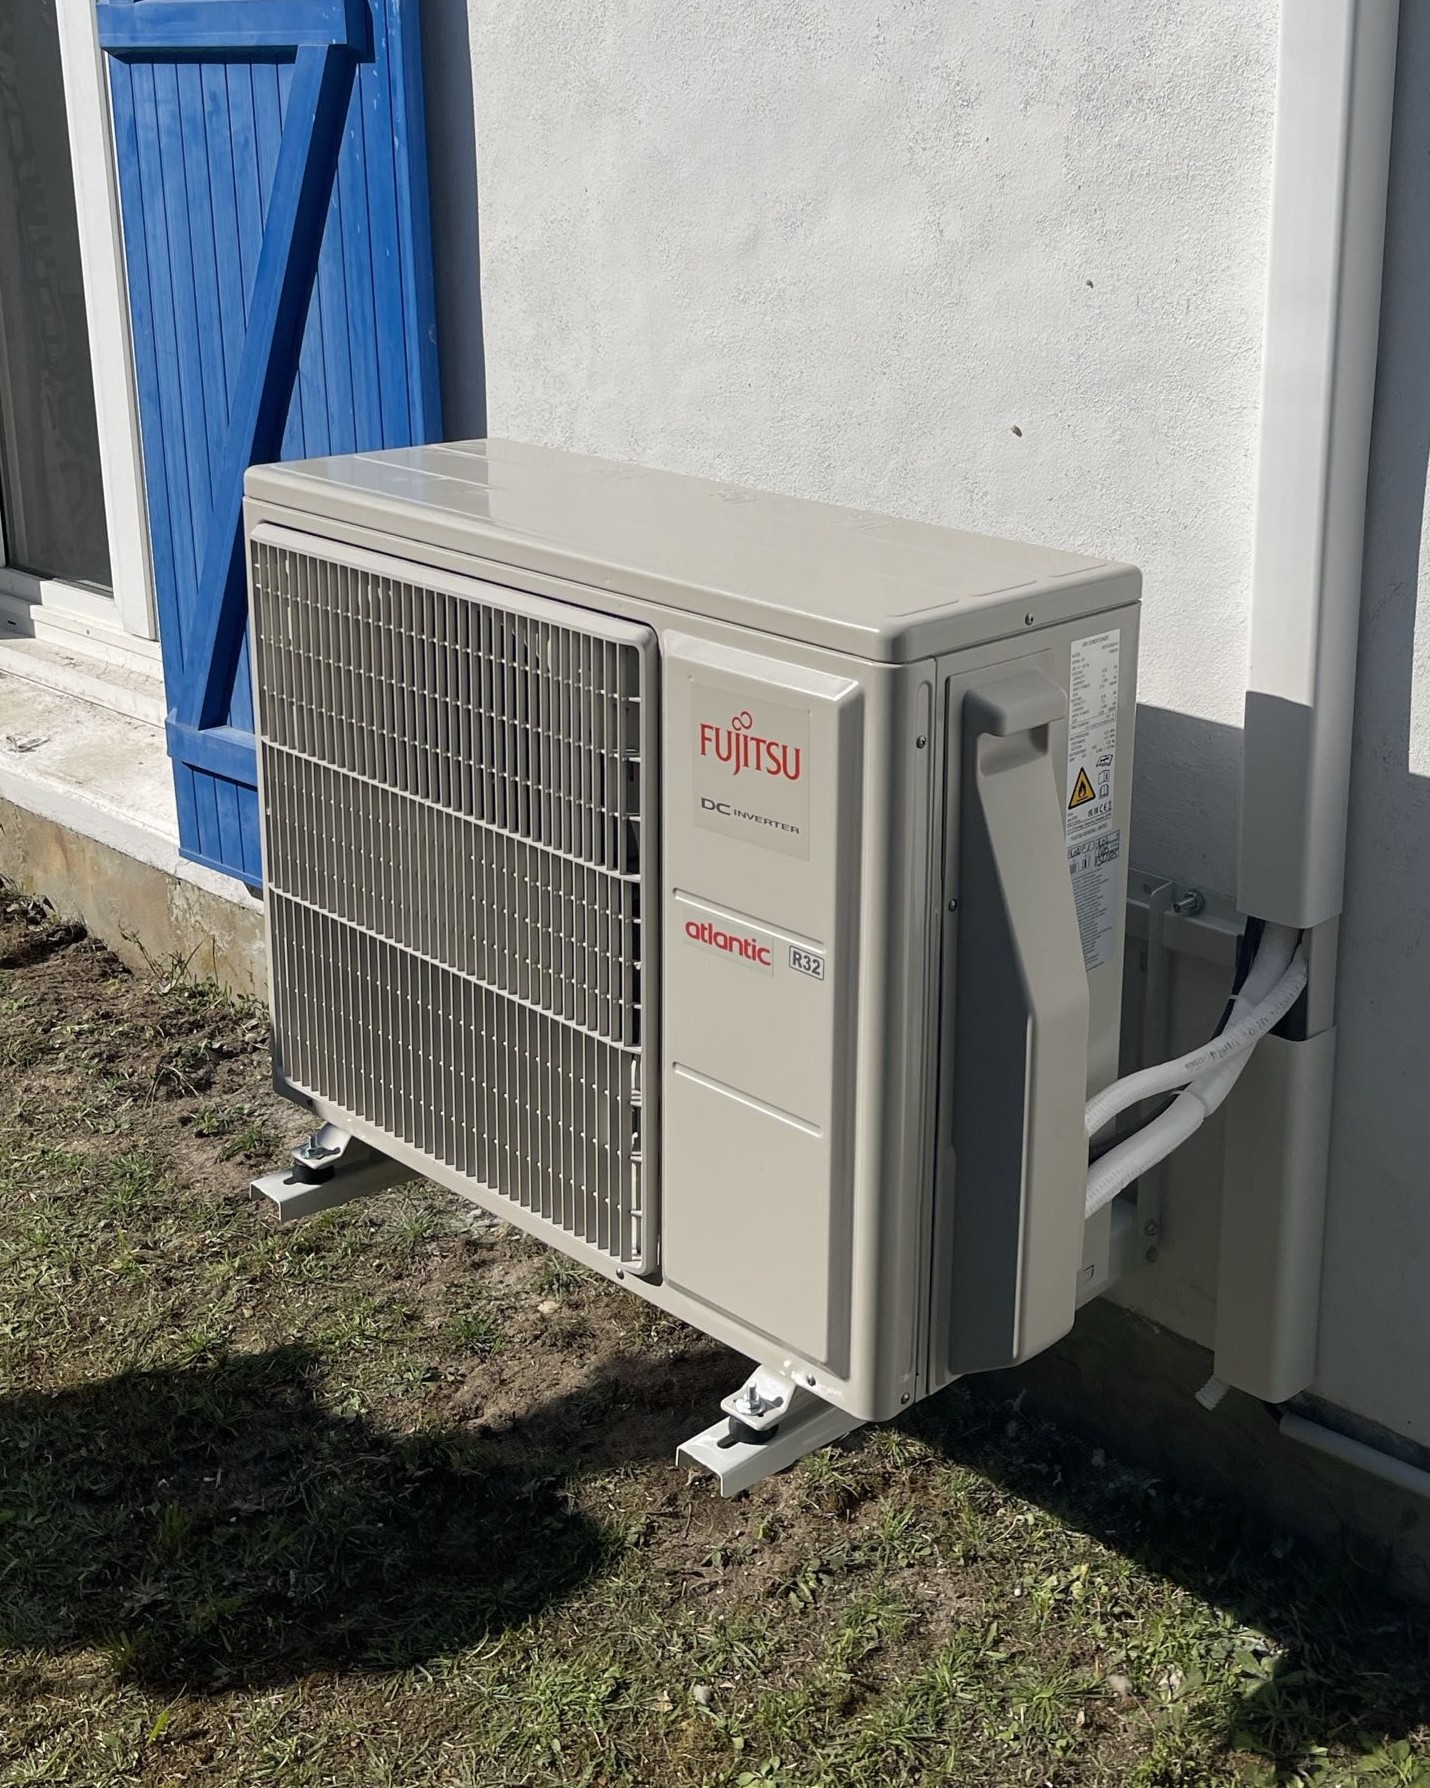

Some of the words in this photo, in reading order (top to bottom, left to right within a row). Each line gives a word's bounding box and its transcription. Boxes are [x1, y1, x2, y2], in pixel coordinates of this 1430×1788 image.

[700, 722, 801, 781] FUJITSU
[701, 797, 731, 816] DC
[733, 808, 800, 835] INVERTER
[685, 921, 771, 966] atlantic
[792, 950, 821, 976] R32
